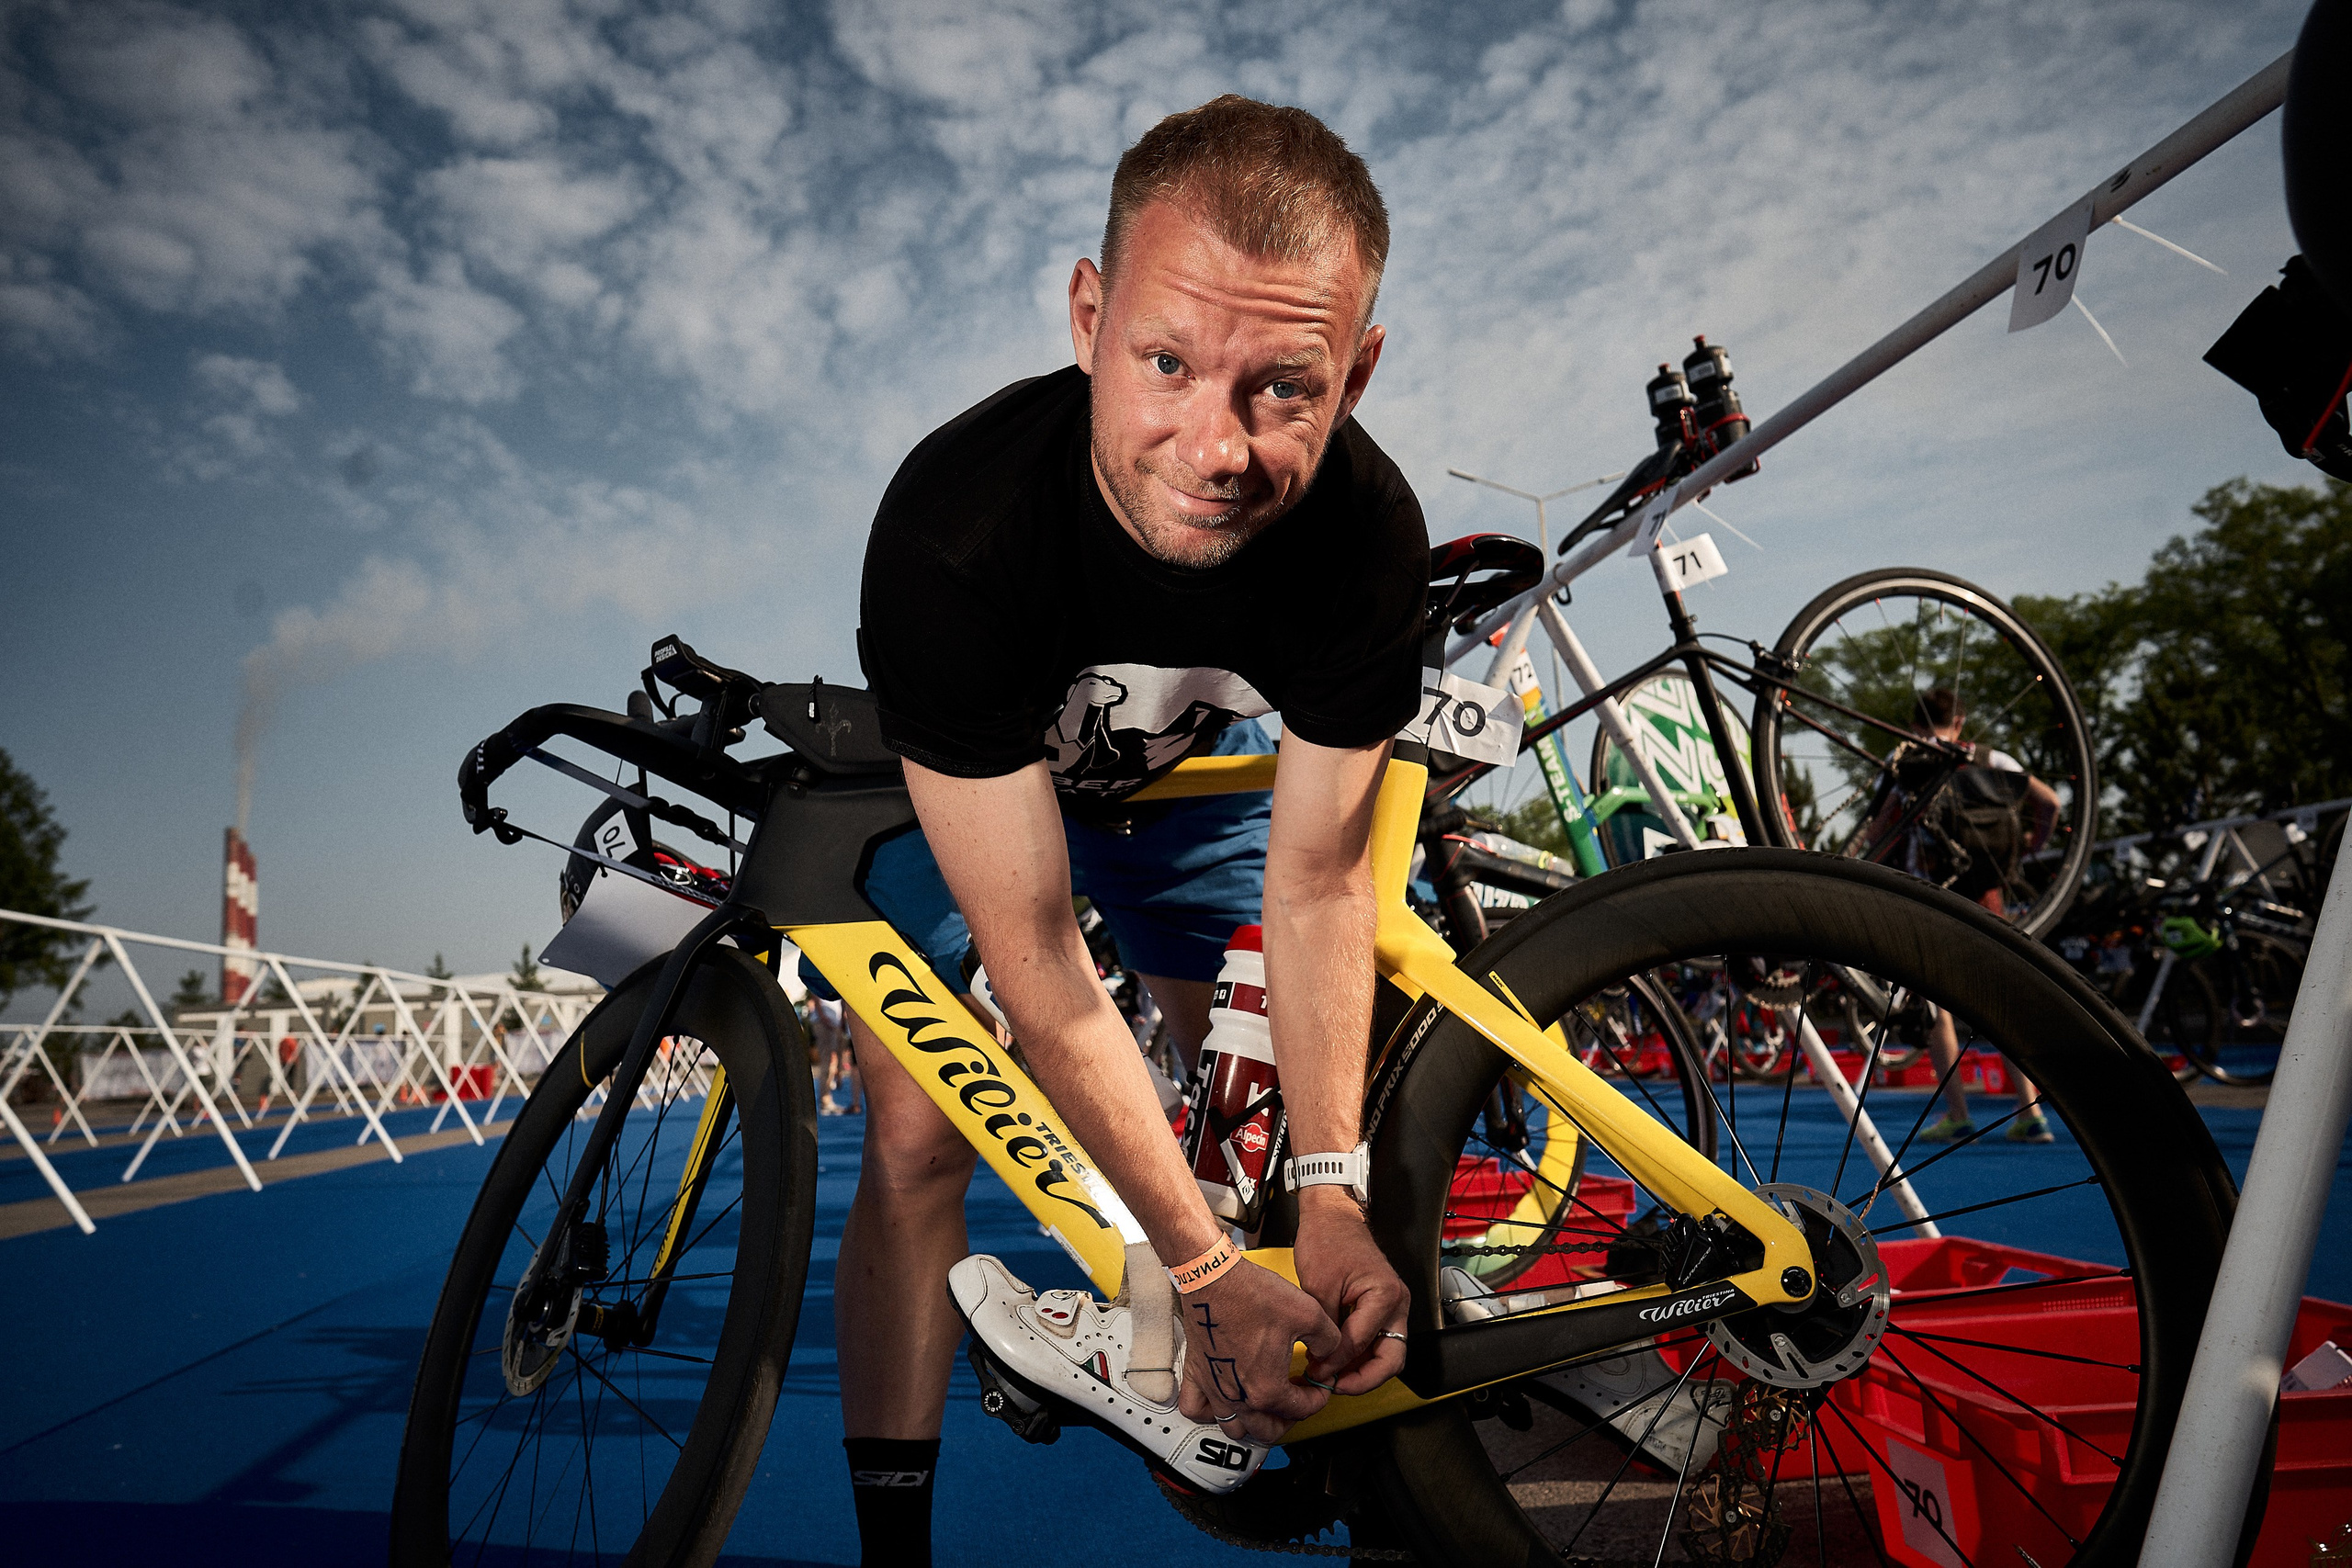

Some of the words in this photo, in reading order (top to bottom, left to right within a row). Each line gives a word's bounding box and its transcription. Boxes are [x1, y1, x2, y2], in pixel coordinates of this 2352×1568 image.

[2033, 243, 2076, 296] 70
[1673, 552, 1702, 576] 71
[1512, 662, 1534, 683] 72
[1423, 685, 1487, 738] 70
[868, 952, 1112, 1229] Wilier
[1364, 1106, 1383, 1143] ND
[1377, 1059, 1405, 1111] PRIX
[1402, 1007, 1438, 1064] 5000
[1235, 1128, 1266, 1146] Alpecin
[1639, 1292, 1736, 1323] Wilier
[1702, 1288, 1735, 1300] TRIESTINA
[1193, 1303, 1248, 1403] 70
[1195, 1438, 1252, 1472] SIDI
[1904, 1478, 1942, 1529] 70
